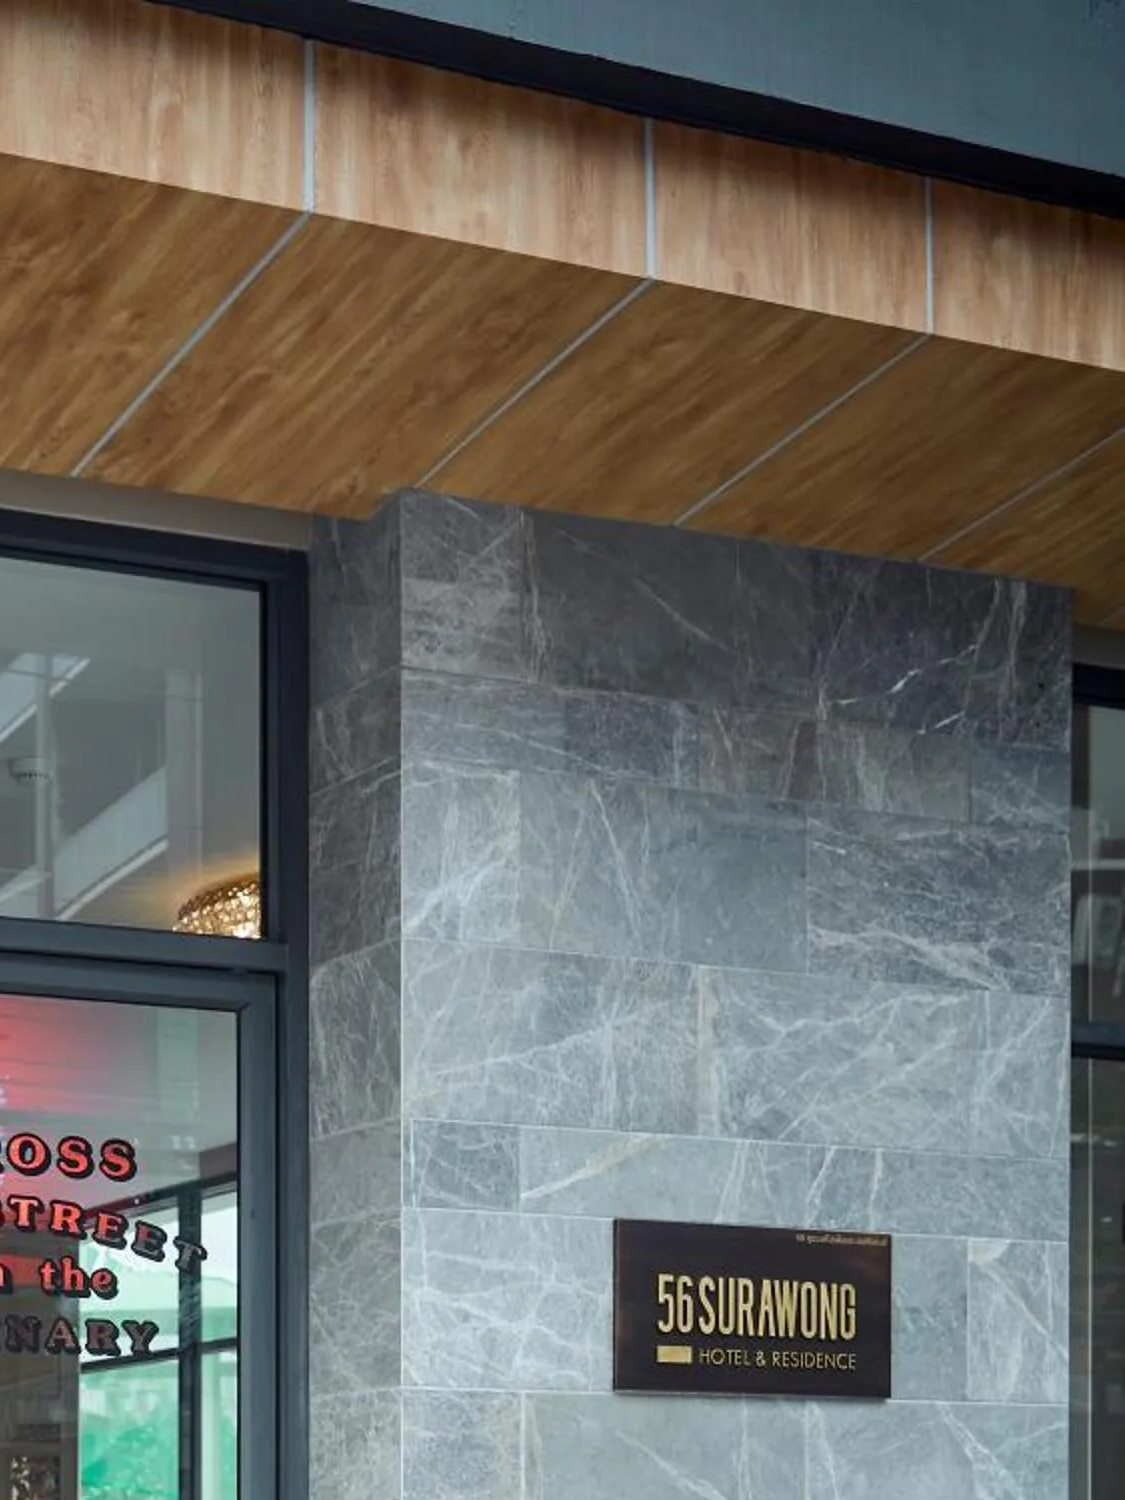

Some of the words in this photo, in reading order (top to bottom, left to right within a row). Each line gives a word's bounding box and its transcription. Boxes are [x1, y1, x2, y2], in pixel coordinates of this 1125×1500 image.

[39, 1257, 118, 1300] the
[699, 1349, 751, 1367] HOTEL
[756, 1351, 767, 1367] &
[772, 1351, 857, 1371] RESIDENCE
